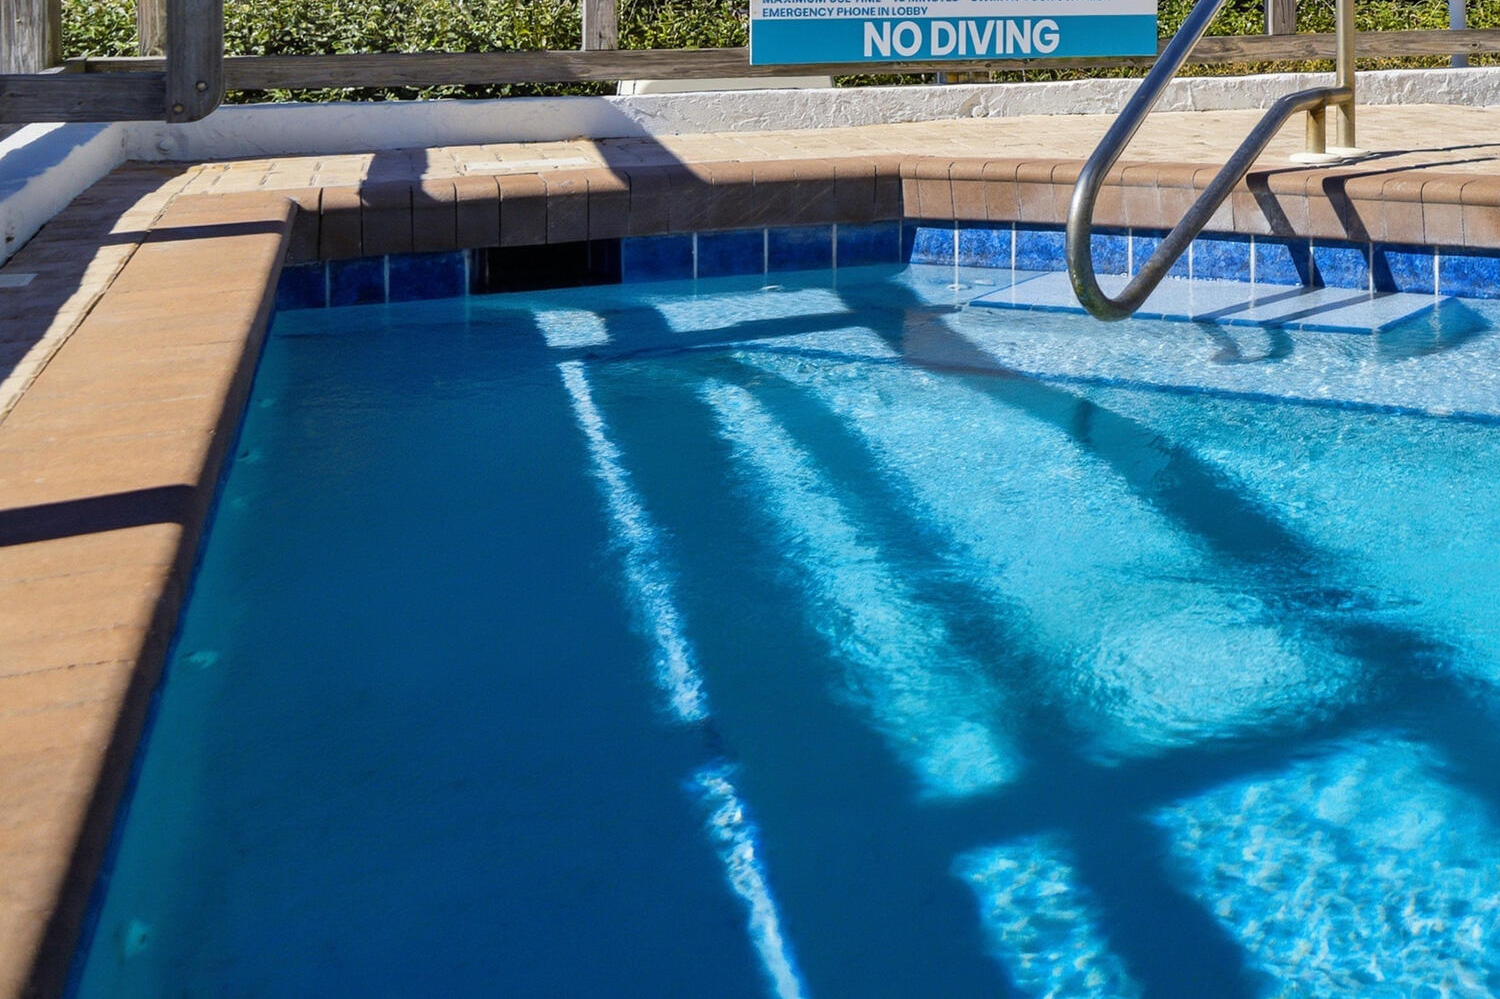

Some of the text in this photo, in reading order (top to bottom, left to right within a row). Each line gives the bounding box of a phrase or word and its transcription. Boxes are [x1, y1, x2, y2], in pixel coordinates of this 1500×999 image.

[763, 7, 928, 17] EMERGENCY PHONE IN LOBBY
[864, 19, 1060, 57] NO DIVING
